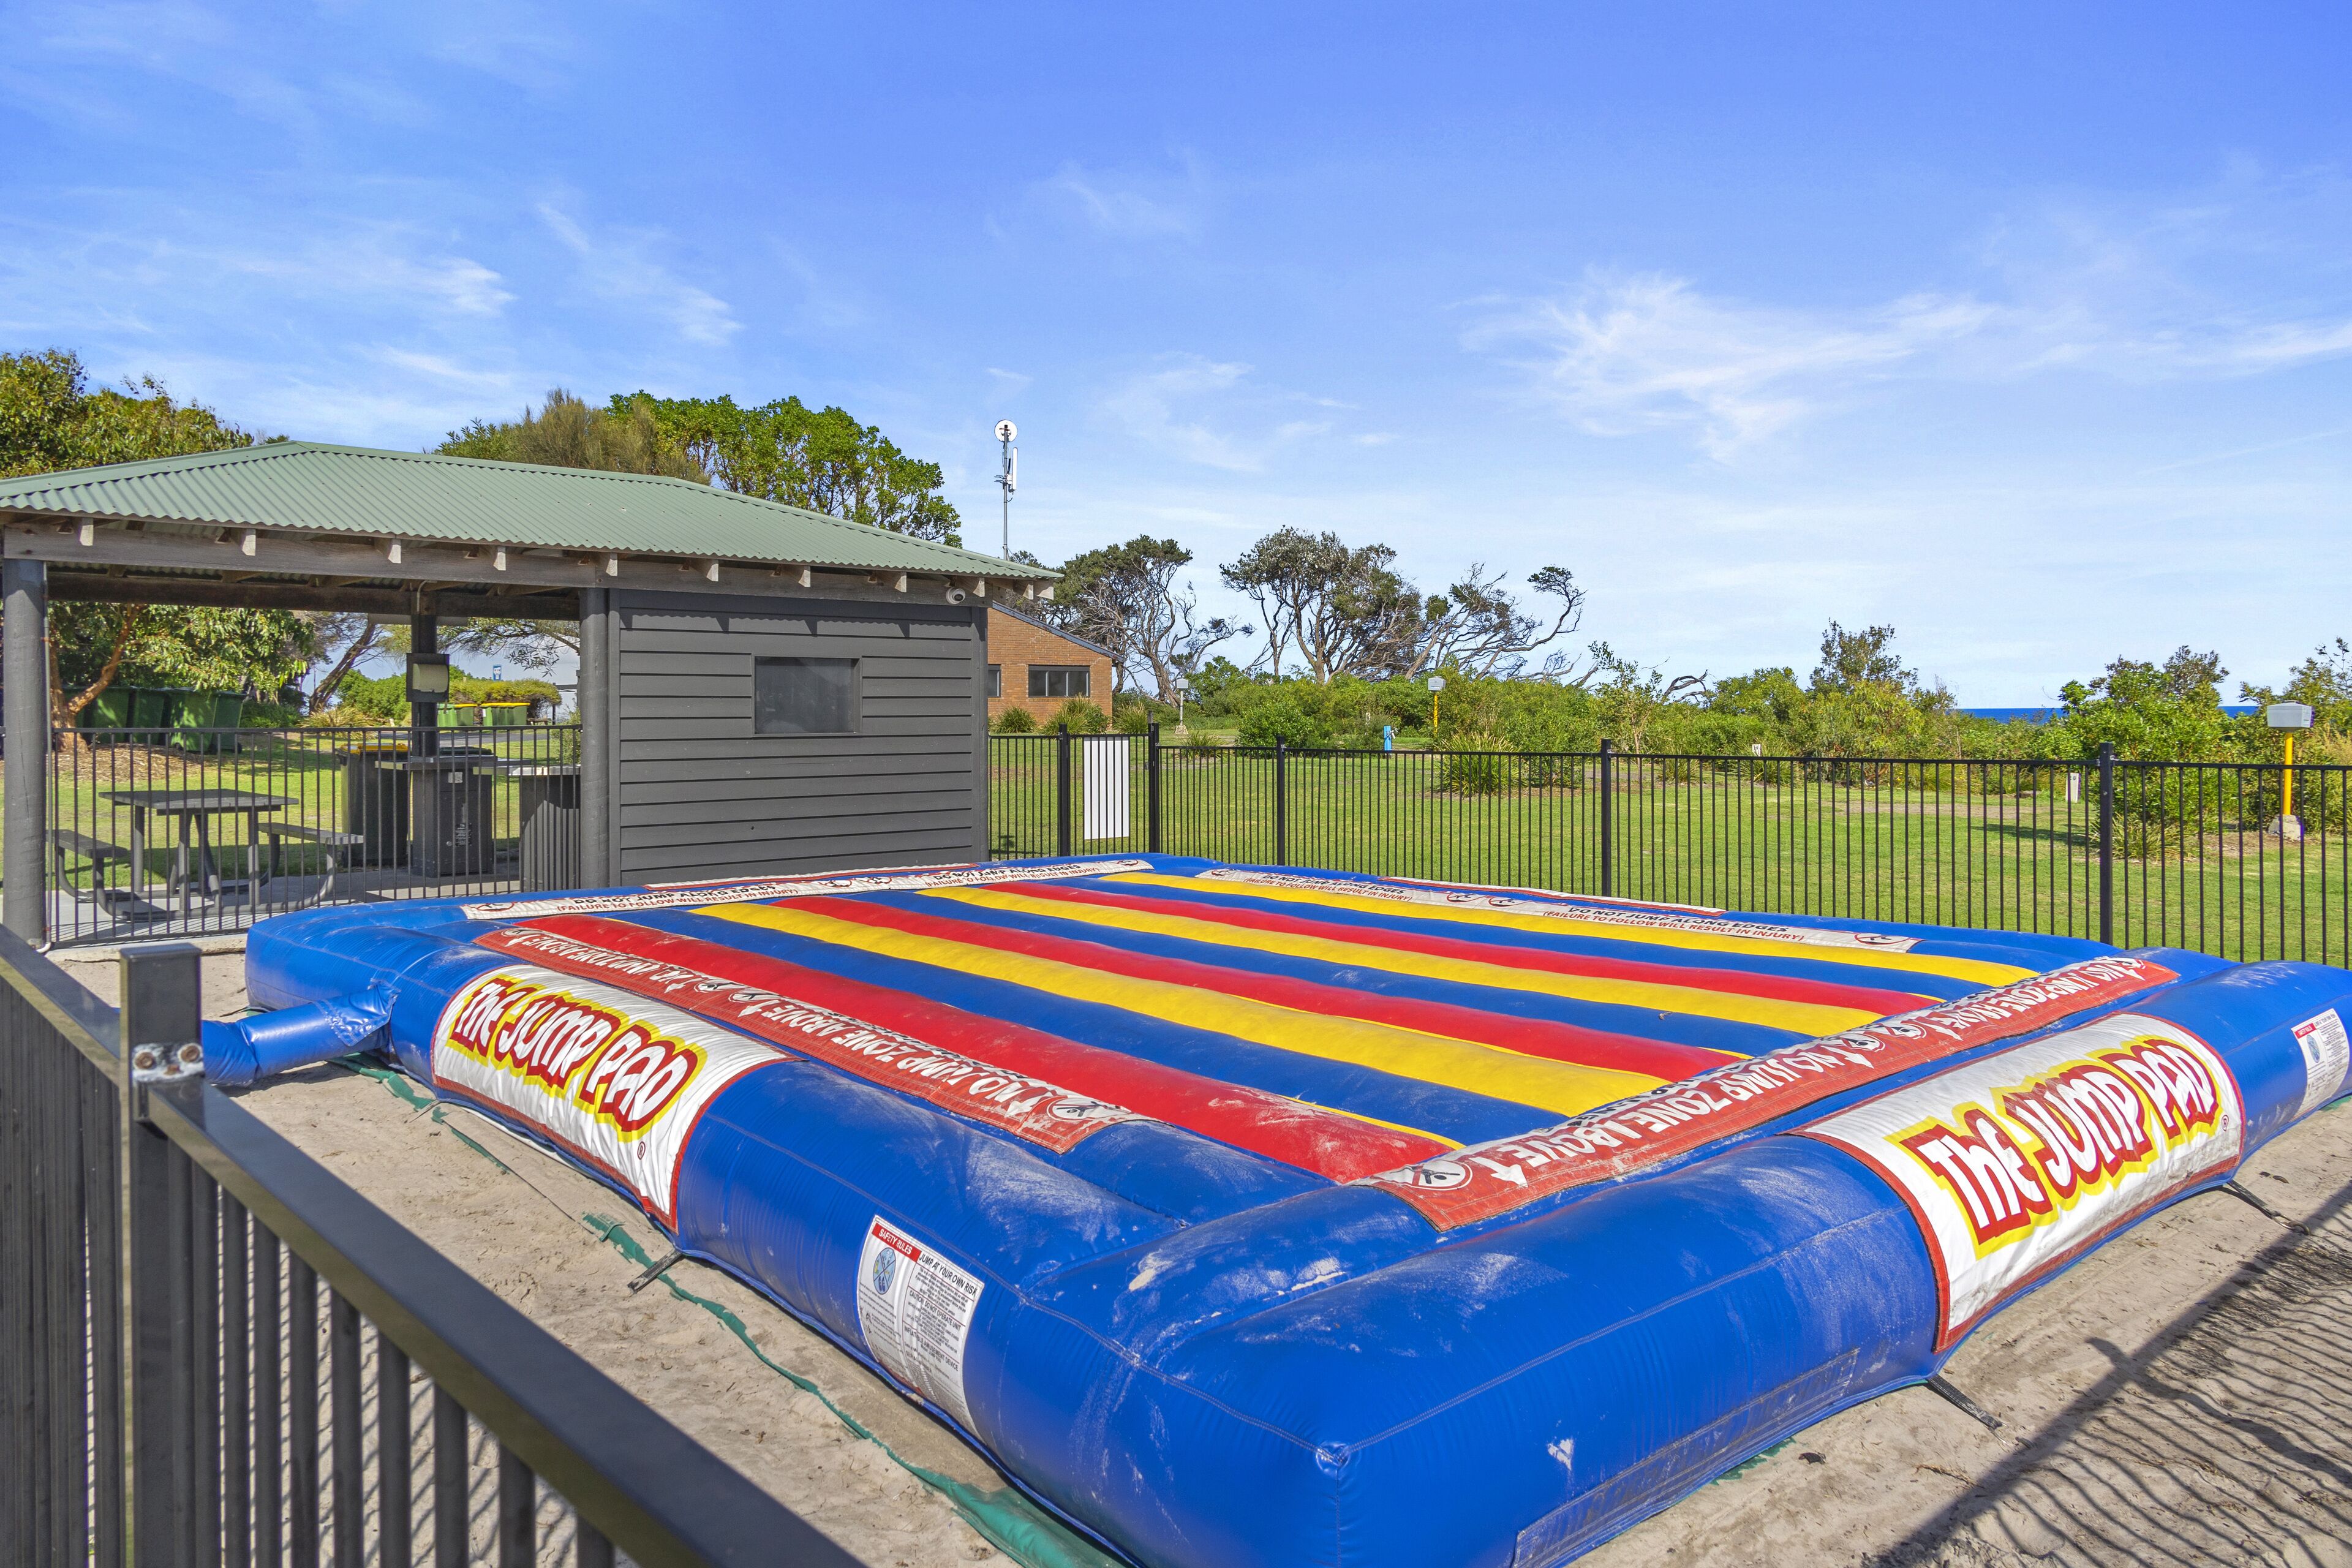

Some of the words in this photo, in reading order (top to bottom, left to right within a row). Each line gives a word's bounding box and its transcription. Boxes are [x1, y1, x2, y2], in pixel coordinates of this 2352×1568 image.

[630, 899, 675, 908] FOLLOW
[706, 894, 742, 903] RESULT
[758, 888, 799, 897] INJURY)
[637, 892, 675, 901] JUMP
[731, 885, 776, 894] EDGES
[1368, 885, 1407, 894] EDGES
[1378, 892, 1412, 902] INJURY)
[1544, 911, 1592, 920] (FAILURE
[1608, 918, 1659, 926] FOLLOW
[1689, 925, 1735, 933] RESULT
[1752, 930, 1804, 941] INJURY)
[1626, 913, 1671, 921] JUMP
[1671, 918, 1730, 927] ALONG
[1732, 922, 1789, 932] EDGES
[761, 1005, 856, 1037] ABOVE
[497, 1000, 612, 1079] JUMP
[831, 1029, 918, 1063] ZONE
[896, 1055, 990, 1085] JUMP
[1782, 1050, 1845, 1072] NO
[969, 1076, 1035, 1102] NO
[1715, 1058, 1803, 1101] JUMP
[1619, 1090, 1733, 1133] ZONE
[2016, 1071, 2146, 1188] JUMP
[878, 1229, 898, 1245] SAFETY
[896, 1240, 913, 1254] RULES
[919, 1253, 933, 1266] JUMP
[932, 1262, 940, 1270] AT
[938, 1265, 952, 1280] YOUR
[952, 1275, 965, 1289] OWN
[964, 1283, 978, 1297] RISK
[910, 1290, 925, 1305] CAUTION!
[937, 1310, 953, 1325] OPERATE
[952, 1321, 961, 1331] UNIT
[945, 1357, 959, 1371] DEVICE
